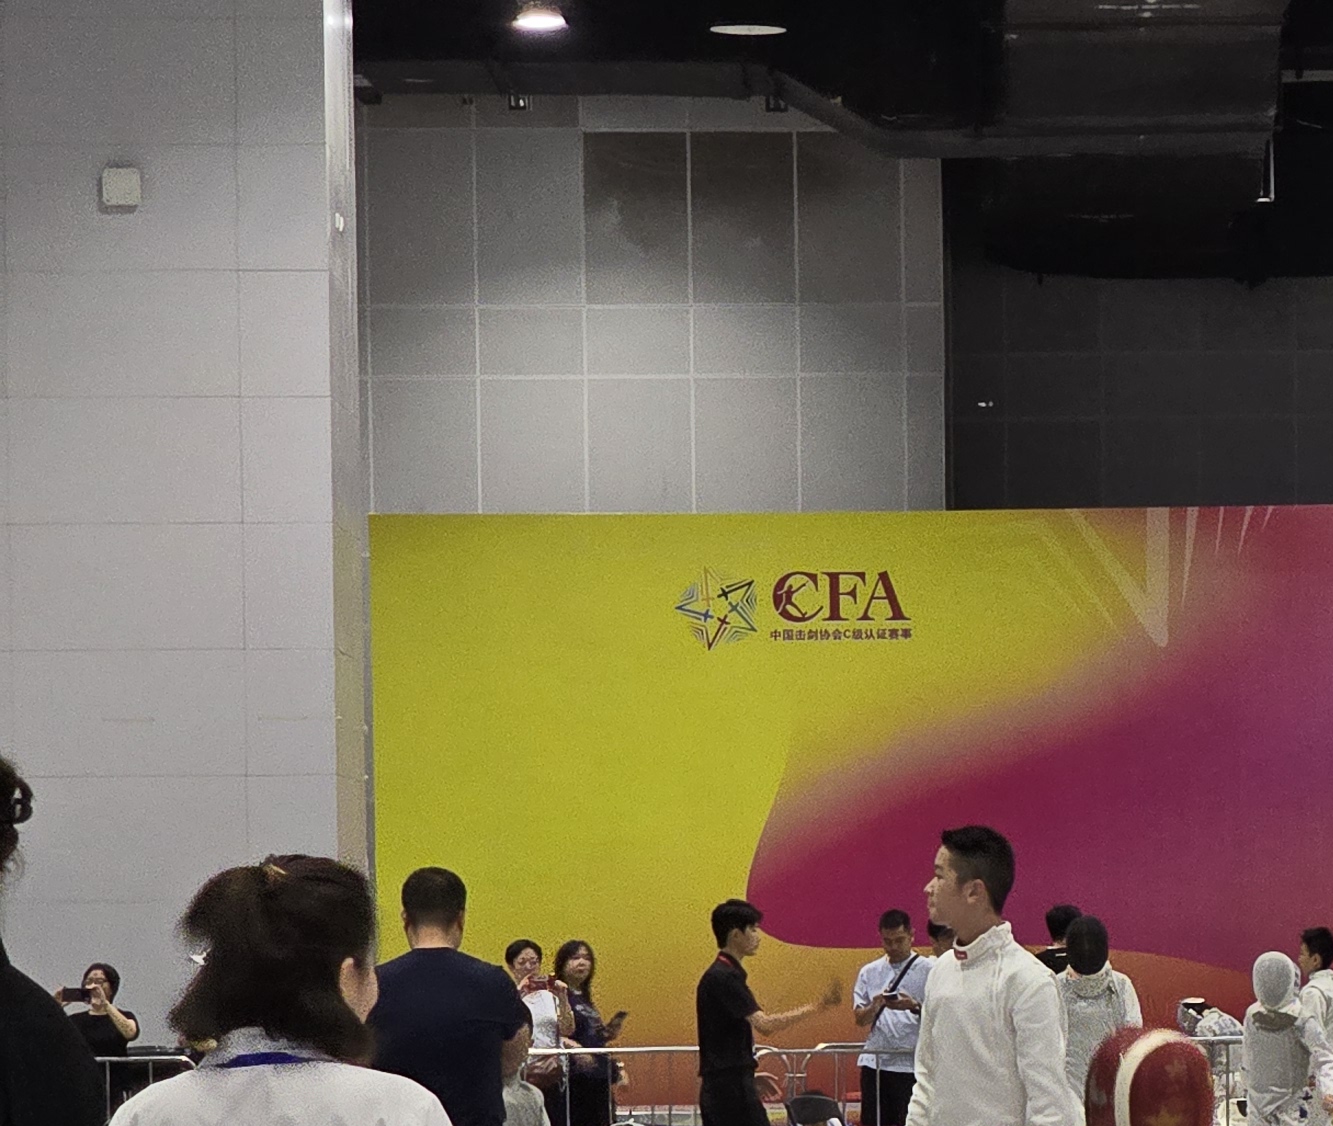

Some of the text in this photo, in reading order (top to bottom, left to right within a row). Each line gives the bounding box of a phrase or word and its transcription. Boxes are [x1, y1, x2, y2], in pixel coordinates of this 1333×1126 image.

[772, 569, 912, 624] CFA
[770, 628, 912, 642] 中国击剑协会C级认证赛事
